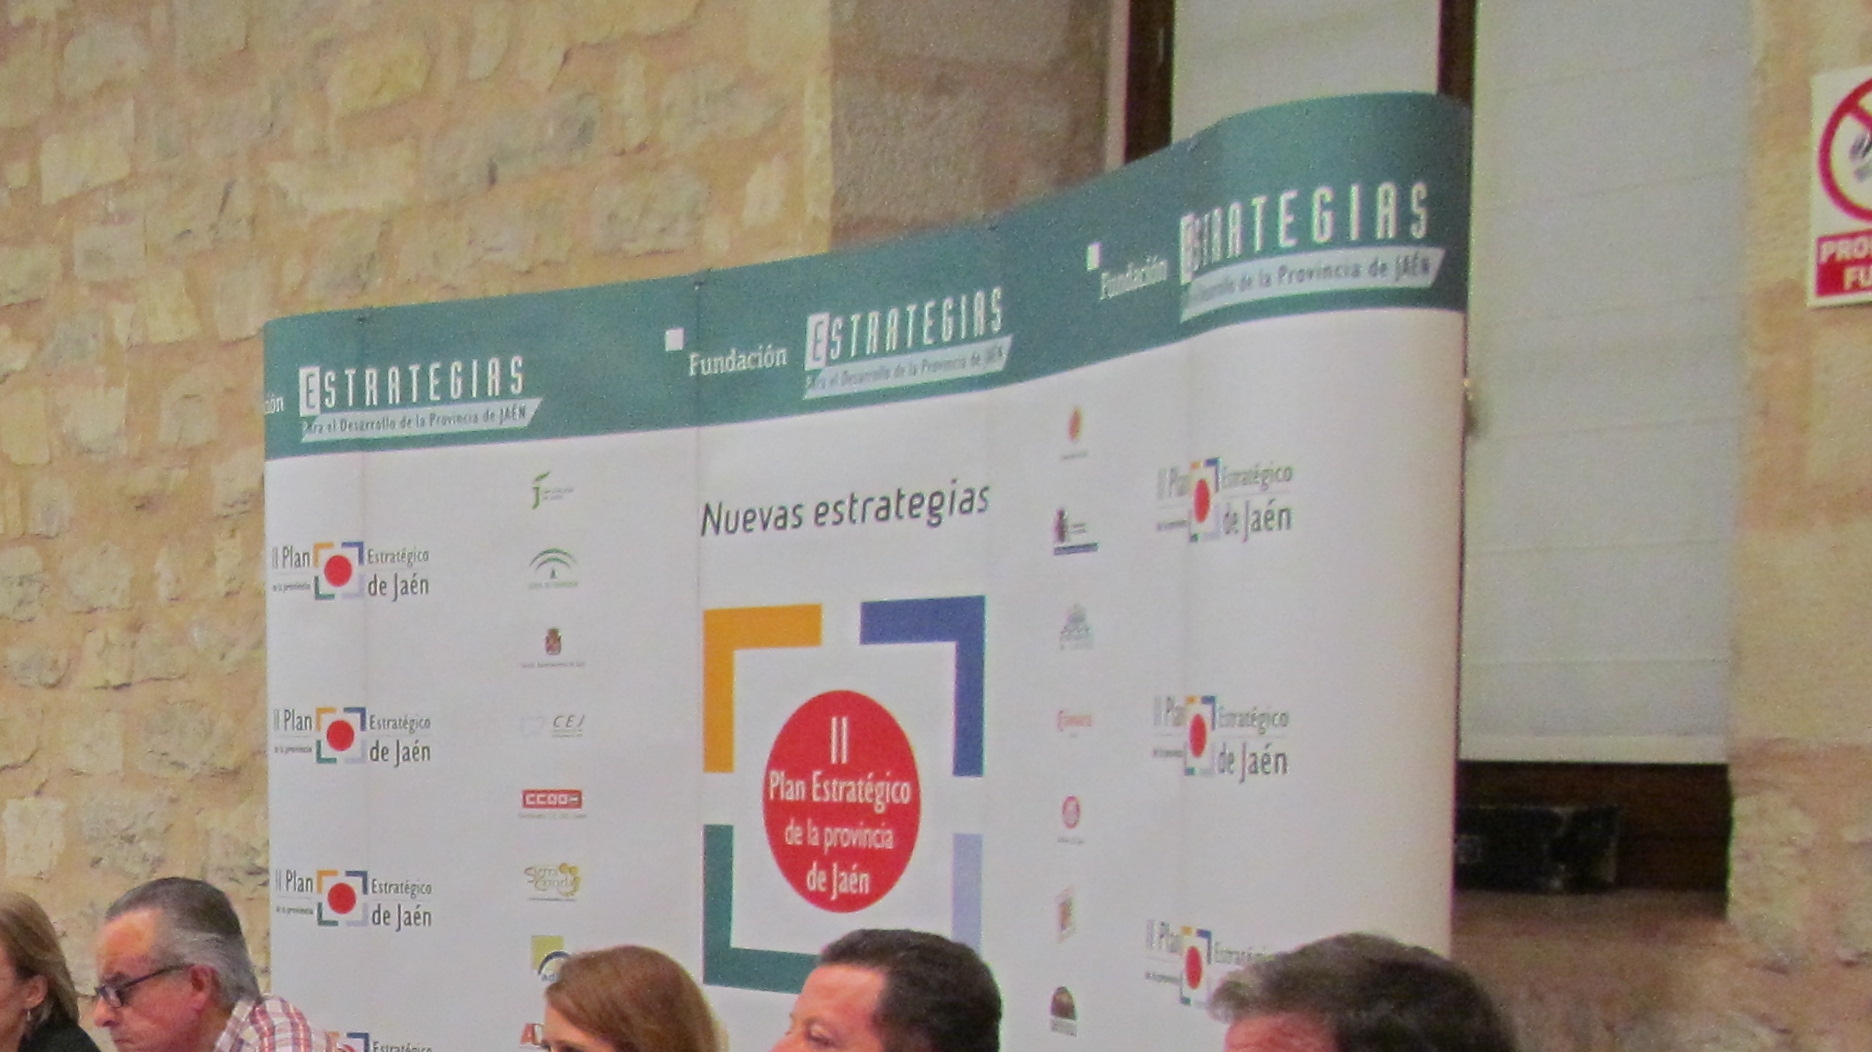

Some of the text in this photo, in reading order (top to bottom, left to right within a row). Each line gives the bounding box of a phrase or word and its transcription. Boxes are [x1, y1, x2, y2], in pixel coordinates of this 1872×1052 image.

[1820, 236, 1872, 264] PRO
[1277, 260, 1361, 284] Provincia
[1368, 257, 1387, 278] de
[1844, 265, 1872, 290] FU
[688, 286, 1003, 377] Fundación ESTRATEGIAS
[300, 355, 523, 413] ESTRATEGIAS
[340, 416, 396, 432] Desarrollo
[400, 414, 412, 429] de
[416, 413, 426, 428] la
[429, 410, 479, 427] Provincia
[483, 408, 495, 421] de
[499, 402, 526, 424] JAÉN
[701, 478, 990, 537] Nuevas estrategias
[1242, 498, 1292, 543] Jaén
[283, 545, 310, 569] Plan
[368, 546, 429, 567] Estratégico
[368, 572, 429, 602] de Jaén
[284, 709, 312, 731] Plan
[370, 713, 431, 734] Estratégico
[370, 740, 430, 768] de Jaén
[1218, 742, 1287, 784] de Jaén
[769, 770, 911, 814] Plan Estratégico
[786, 817, 894, 856] de la provincia
[286, 870, 314, 893] Plan
[371, 879, 432, 899] Estratégico
[807, 860, 870, 901] de Jaén
[372, 903, 432, 932] de Jaén
